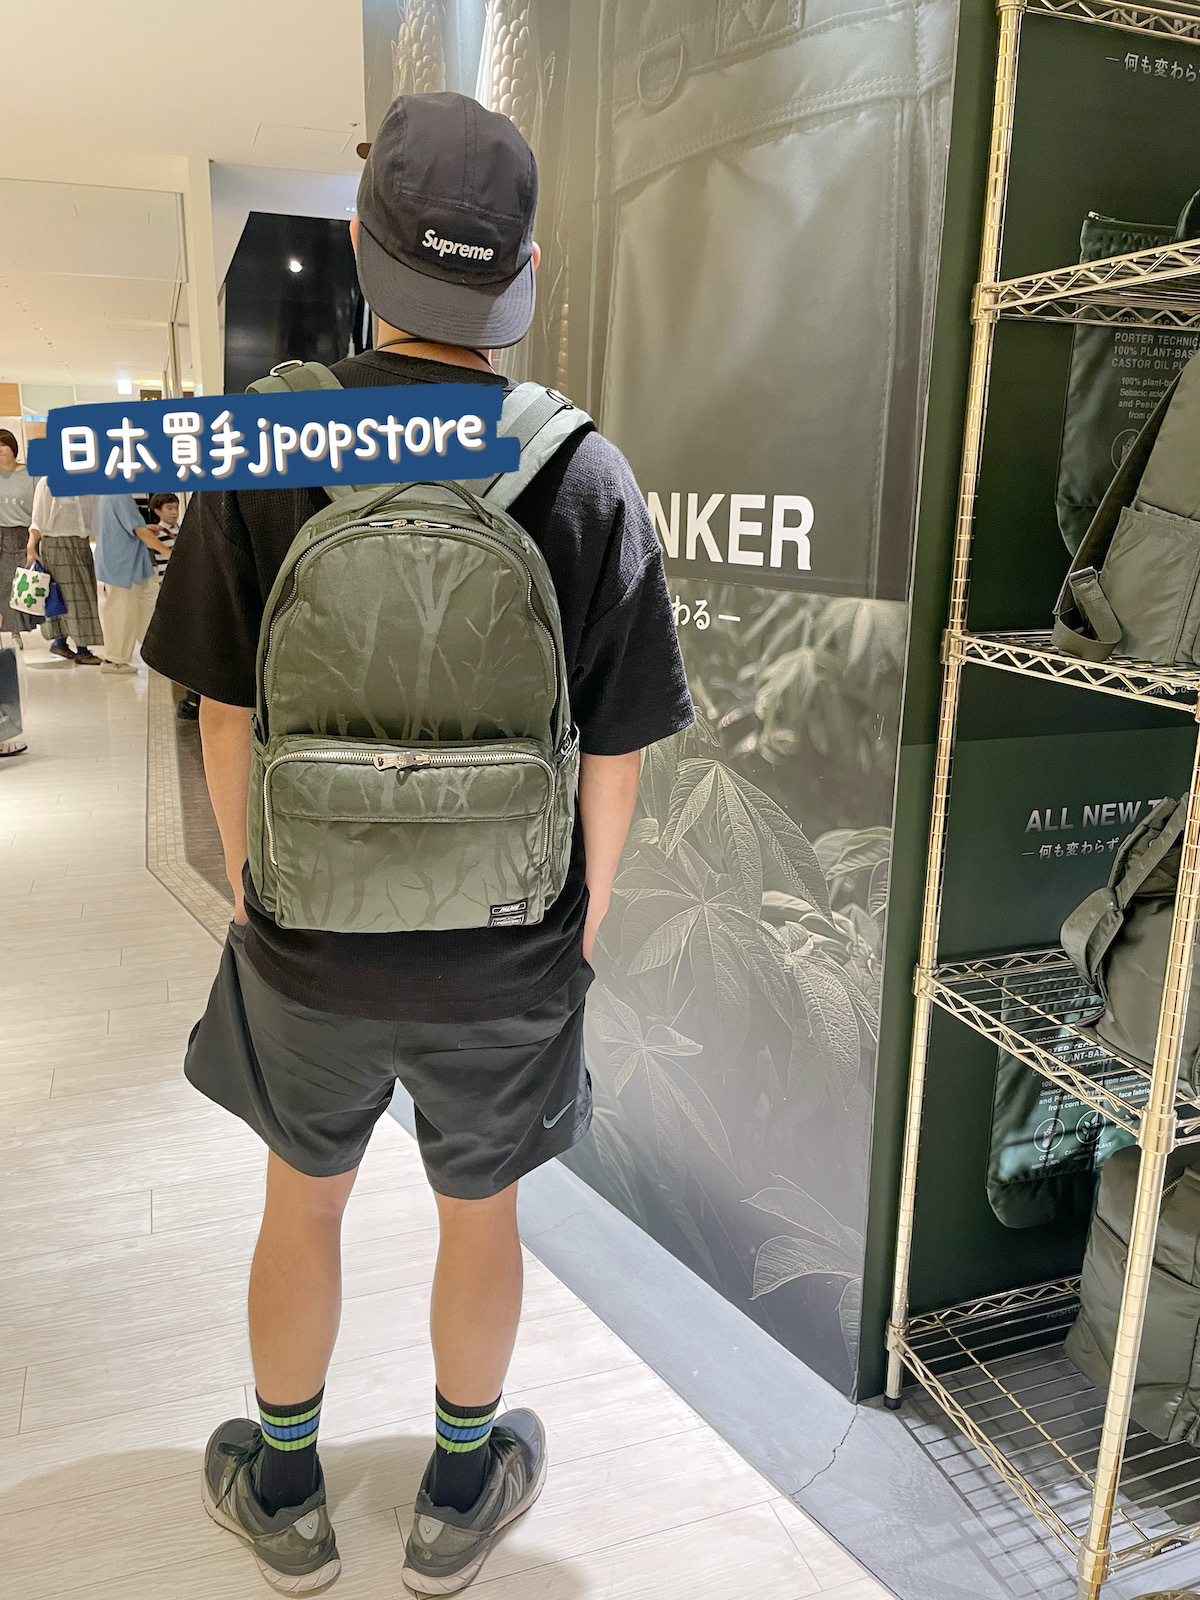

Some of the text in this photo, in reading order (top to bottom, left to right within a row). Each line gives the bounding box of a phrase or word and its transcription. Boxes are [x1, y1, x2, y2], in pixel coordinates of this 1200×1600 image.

[421, 228, 494, 261] Supreme
[1114, 332, 1154, 344] PORTER
[1113, 346, 1138, 356] 100%
[1111, 357, 1151, 369] CASTOR
[1154, 360, 1170, 370] OIL
[647, 491, 815, 571] NKER
[1024, 806, 1075, 834] ALL
[1081, 800, 1143, 828] NEW
